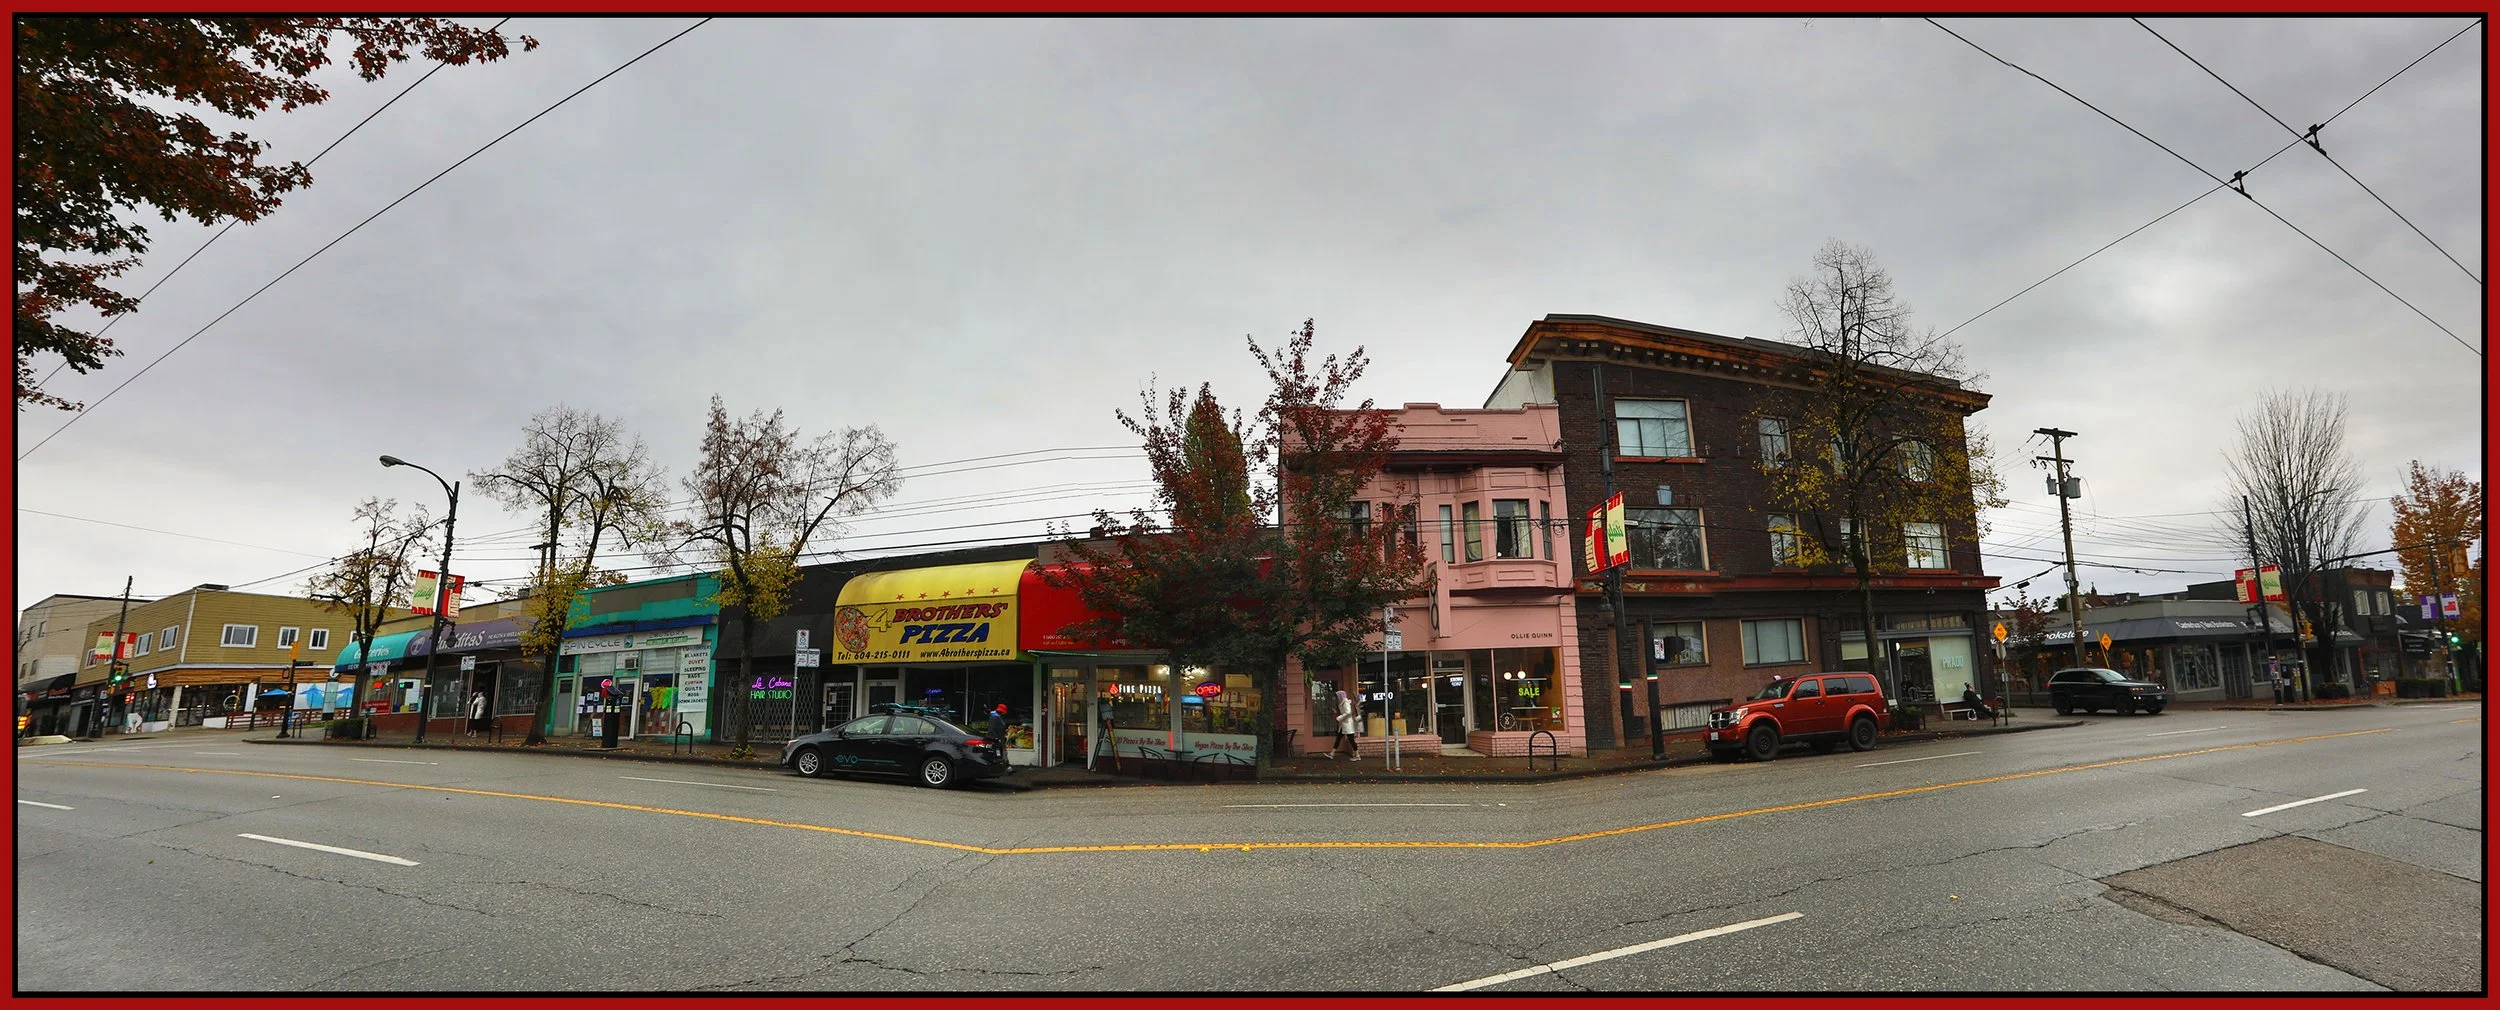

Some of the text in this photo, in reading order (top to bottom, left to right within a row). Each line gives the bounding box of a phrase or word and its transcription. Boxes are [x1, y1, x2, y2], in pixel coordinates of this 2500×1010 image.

[413, 587, 434, 600] italy
[867, 607, 889, 632] 4
[899, 622, 990, 644] PIZZA
[564, 638, 621, 651] SPIN CYCLE
[837, 648, 1011, 661] Tel: 604-215-0111 www.4brotherspizza.ca
[750, 690, 792, 699] HAIR STUDIO
[1196, 685, 1222, 695] OPEN
[1518, 687, 1540, 698] SALE
[835, 754, 859, 764] evo
